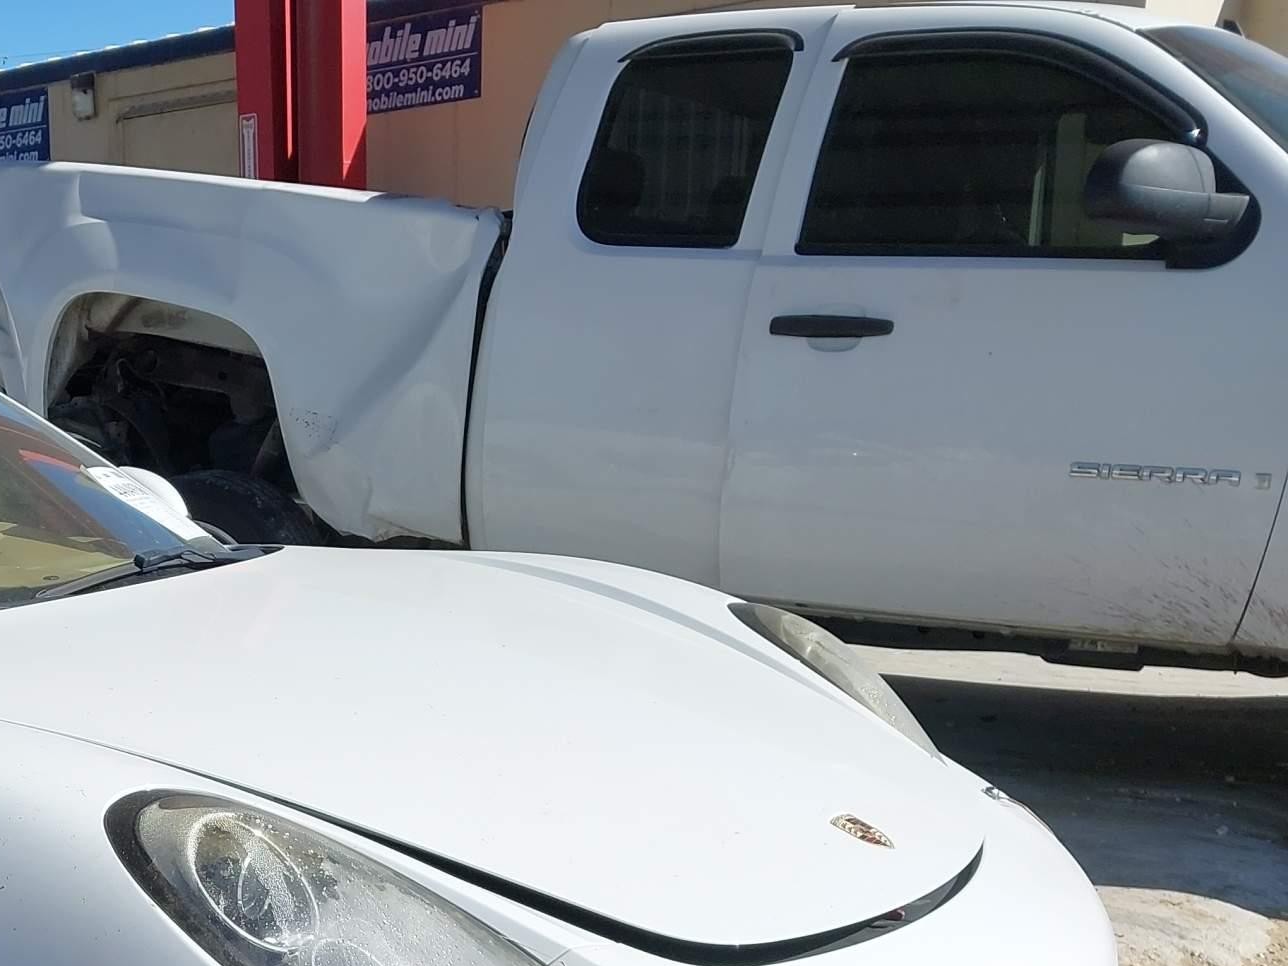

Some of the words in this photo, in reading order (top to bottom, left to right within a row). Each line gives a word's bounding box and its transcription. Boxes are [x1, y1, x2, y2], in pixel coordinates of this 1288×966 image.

[367, 22, 422, 66] obile
[423, 16, 478, 56] mini
[9, 95, 46, 127] mini
[1069, 461, 1242, 487] SIERRA
